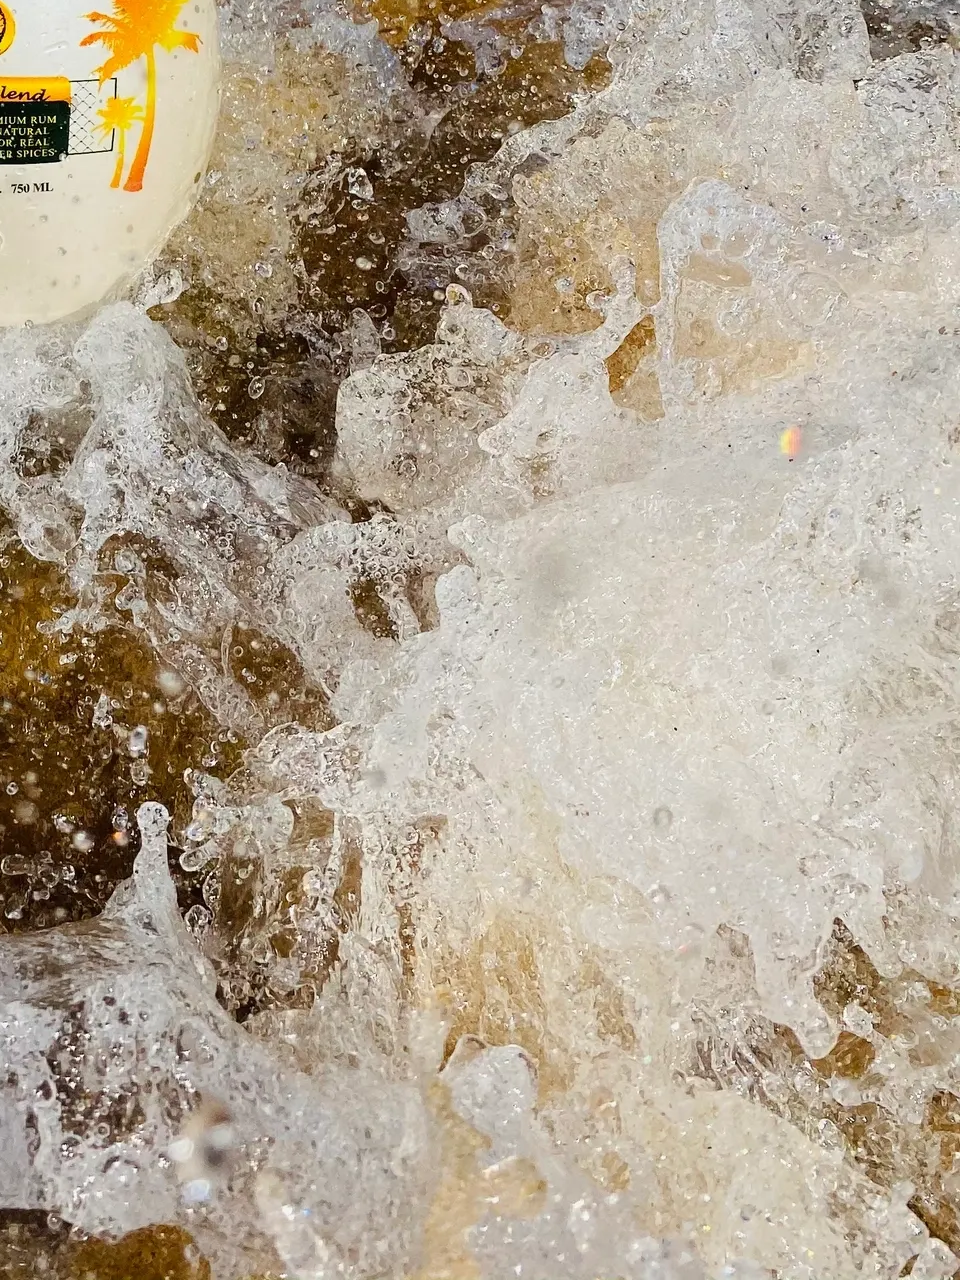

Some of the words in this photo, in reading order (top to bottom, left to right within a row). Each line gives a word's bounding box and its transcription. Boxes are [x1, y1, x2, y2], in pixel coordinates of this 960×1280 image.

[32, 116, 57, 126] RUM
[20, 136, 50, 147] REAL
[17, 149, 55, 158] SPICES
[10, 183, 30, 194] 750
[33, 182, 54, 193] ML
